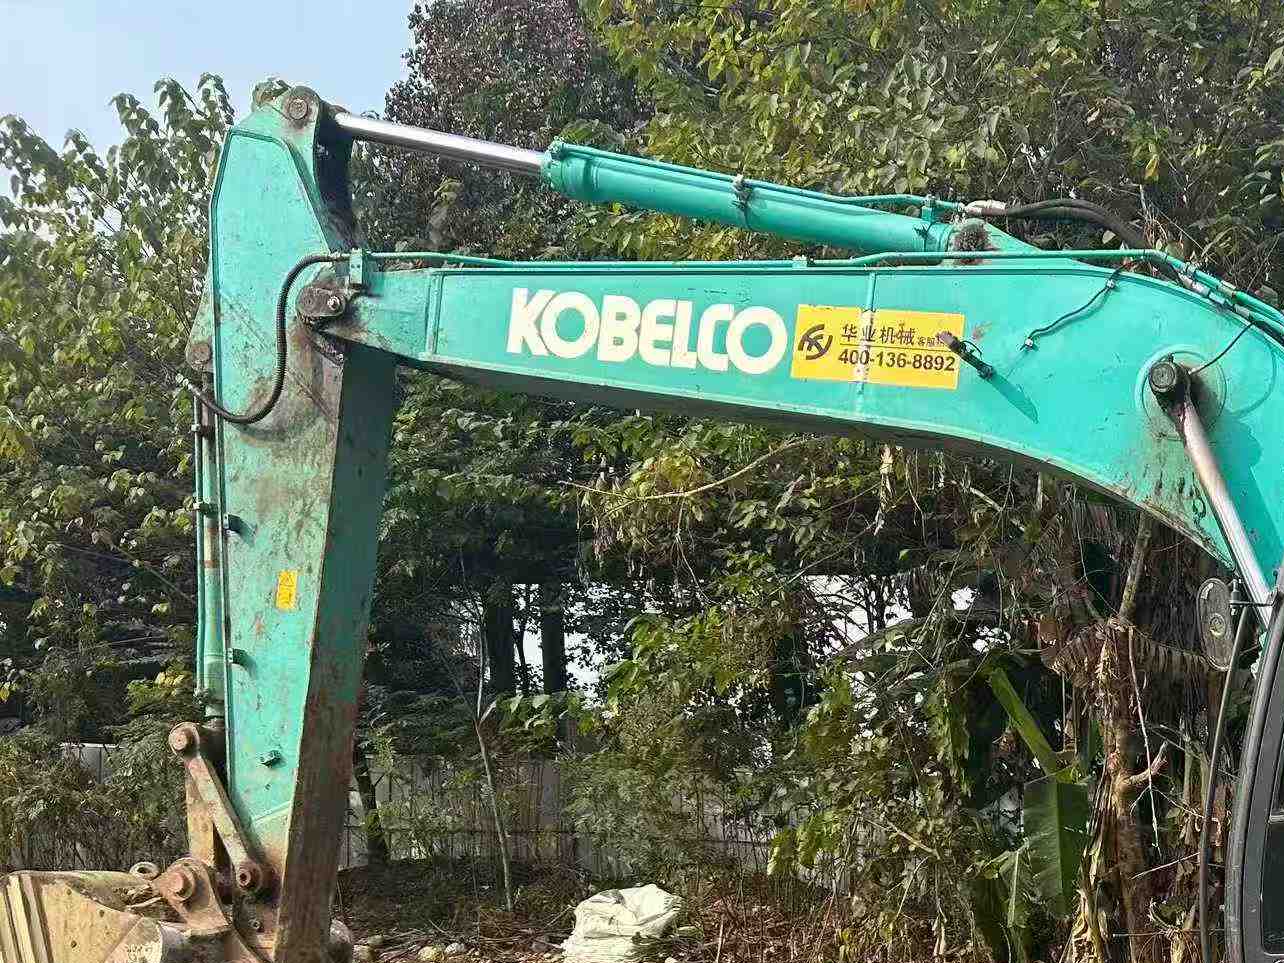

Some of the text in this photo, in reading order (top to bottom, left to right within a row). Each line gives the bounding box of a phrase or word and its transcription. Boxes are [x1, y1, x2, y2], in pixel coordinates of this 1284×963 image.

[506, 287, 788, 375] KOBELCO
[840, 322, 915, 346] 华业机械
[838, 348, 956, 372] 400-136-8892
